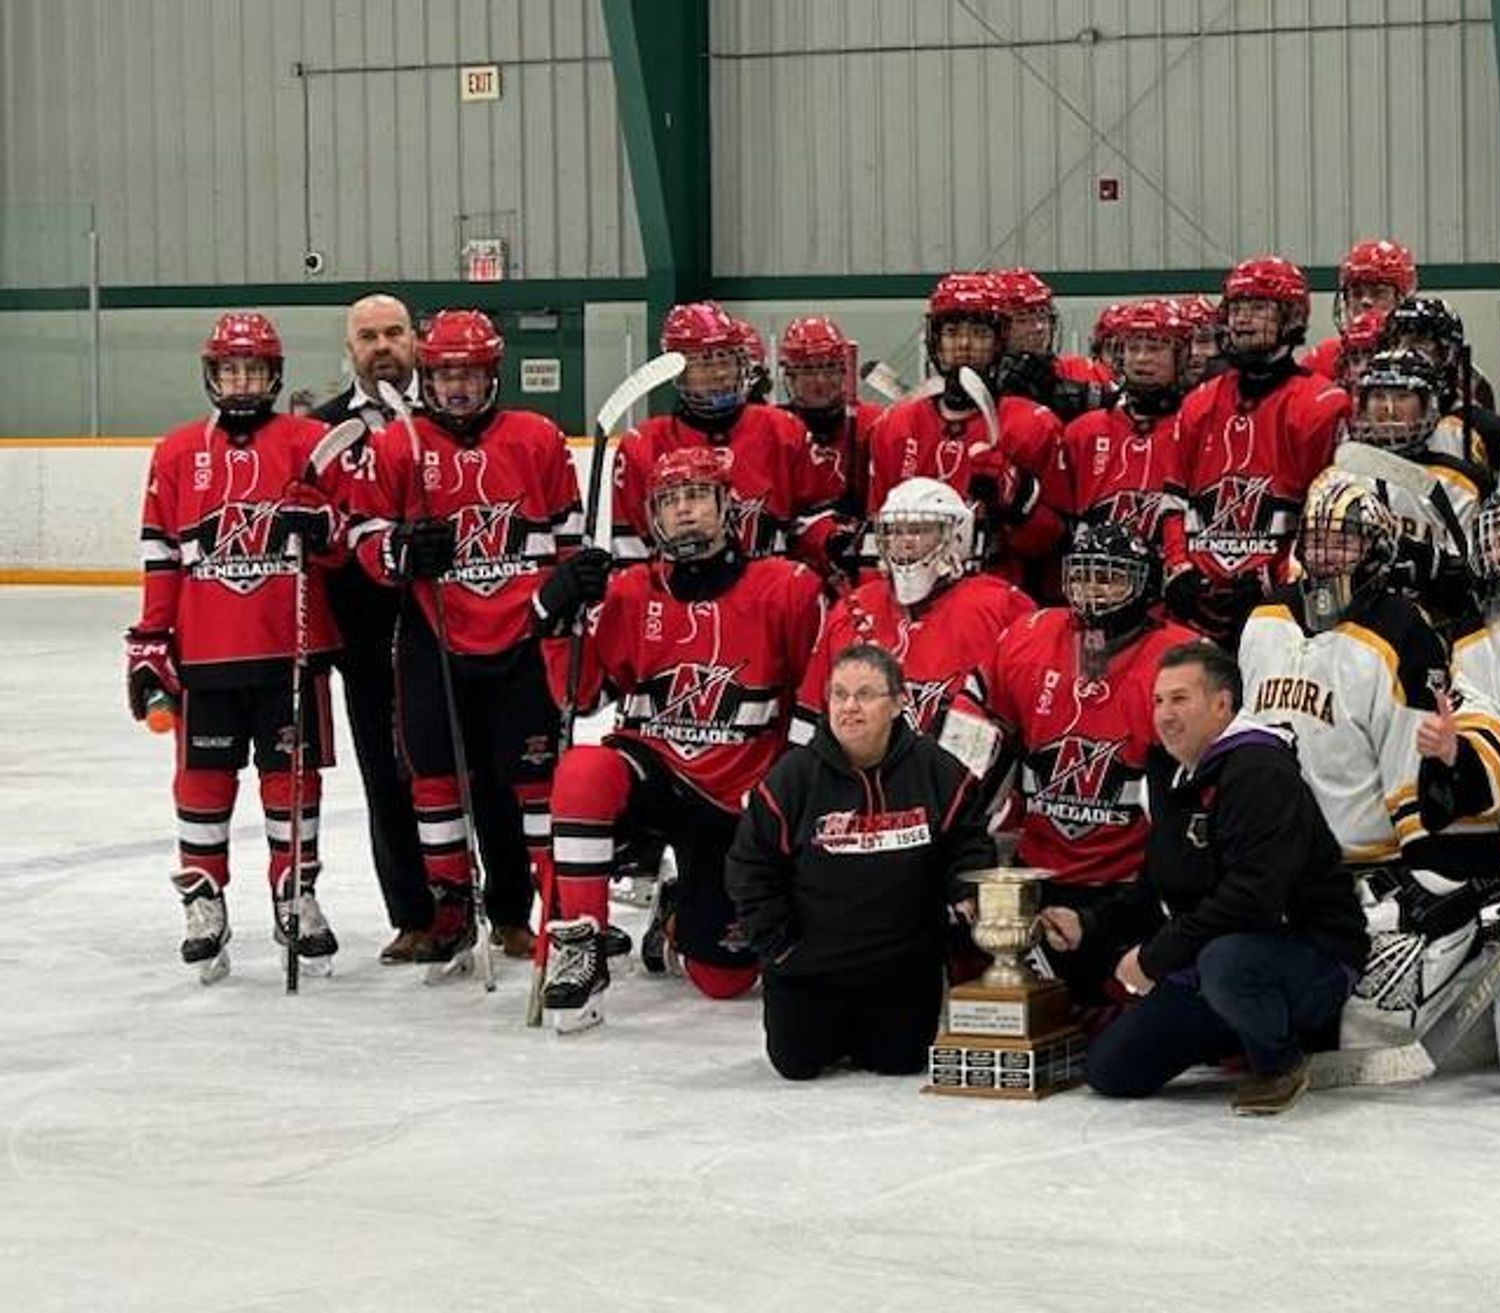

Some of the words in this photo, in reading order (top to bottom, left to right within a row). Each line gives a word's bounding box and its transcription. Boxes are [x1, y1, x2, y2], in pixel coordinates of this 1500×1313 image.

[469, 72, 493, 94] EXIT
[1189, 538, 1278, 555] RENEGADES
[1255, 677, 1336, 728] AURORA
[640, 722, 750, 745] RENEGADES
[1027, 798, 1131, 825] RENEGADES
